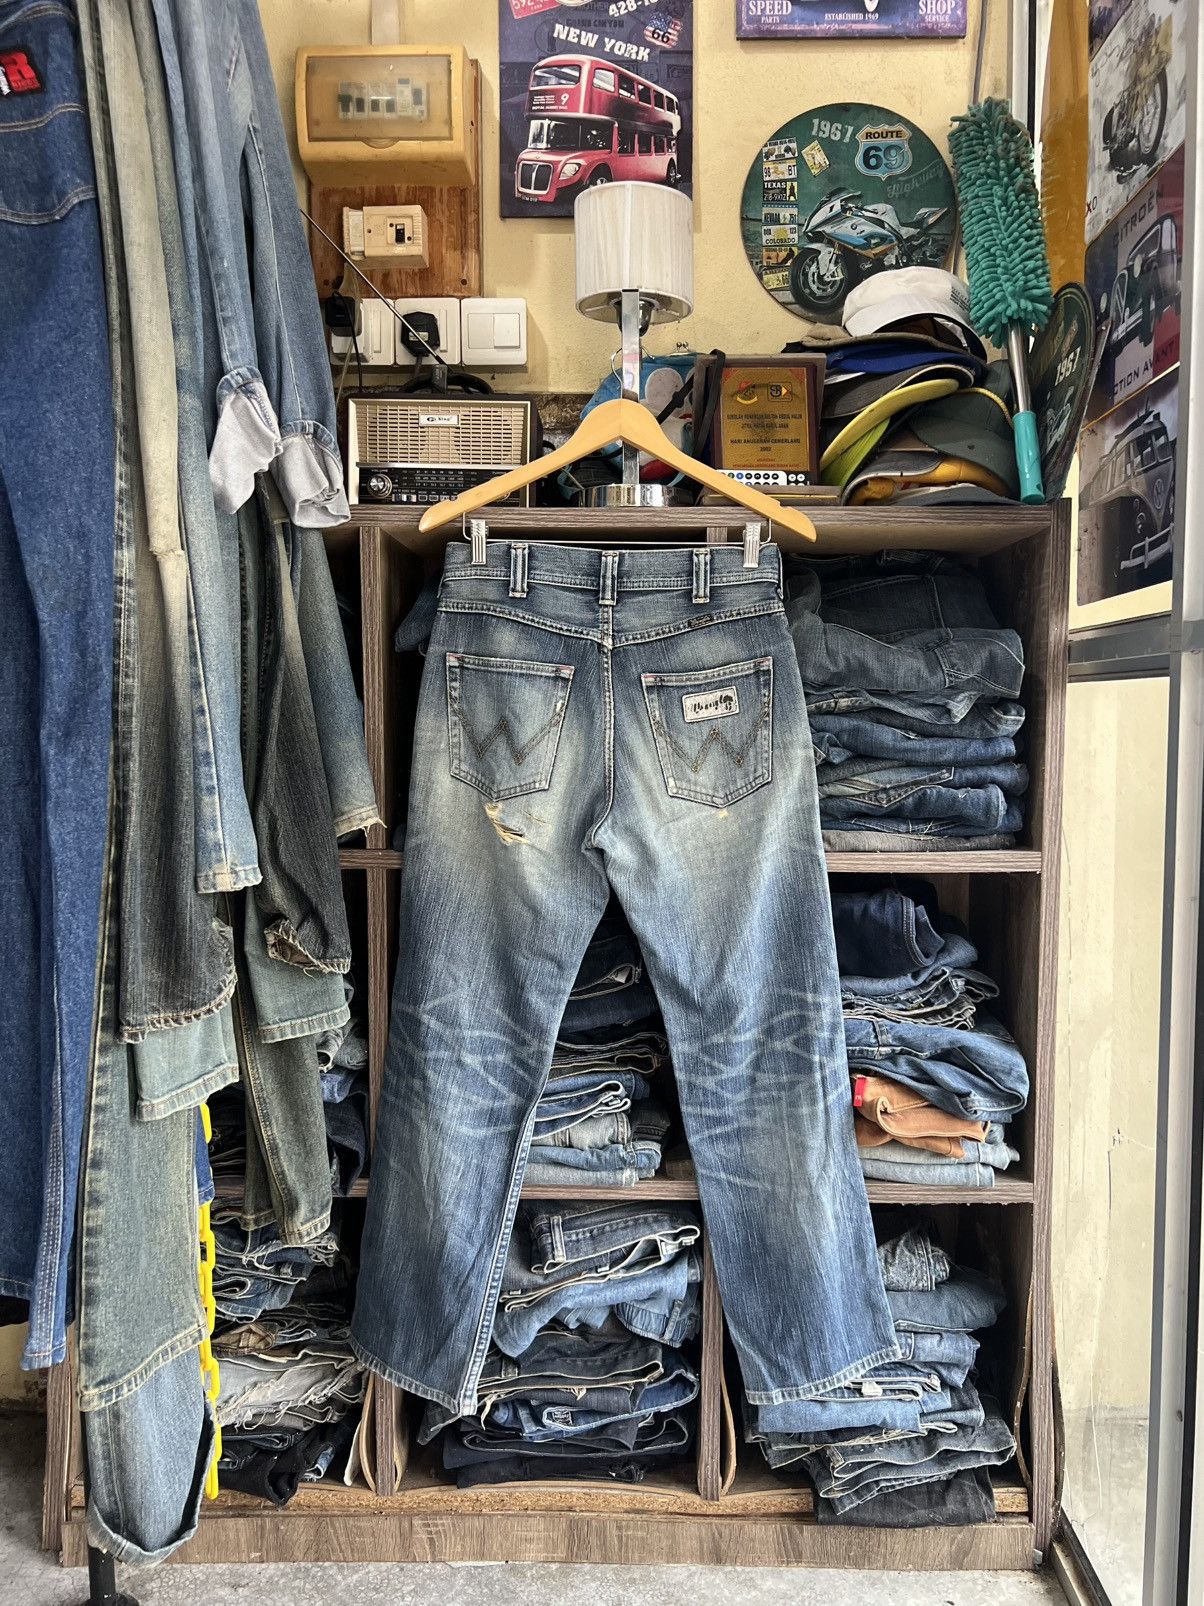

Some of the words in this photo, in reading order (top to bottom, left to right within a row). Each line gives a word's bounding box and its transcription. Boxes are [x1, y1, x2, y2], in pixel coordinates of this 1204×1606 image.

[749, 0, 792, 15] SPEED
[919, 0, 955, 15] SHOP
[825, 13, 864, 21] ESTABLISHED
[552, 23, 599, 48] NEW
[603, 37, 651, 62] YORK
[651, 28, 672, 43] 66
[561, 93, 569, 105] 9
[811, 119, 854, 143] 1967
[865, 130, 903, 140] ROUTE
[863, 145, 905, 171] 69
[1055, 346, 1081, 386] 1967
